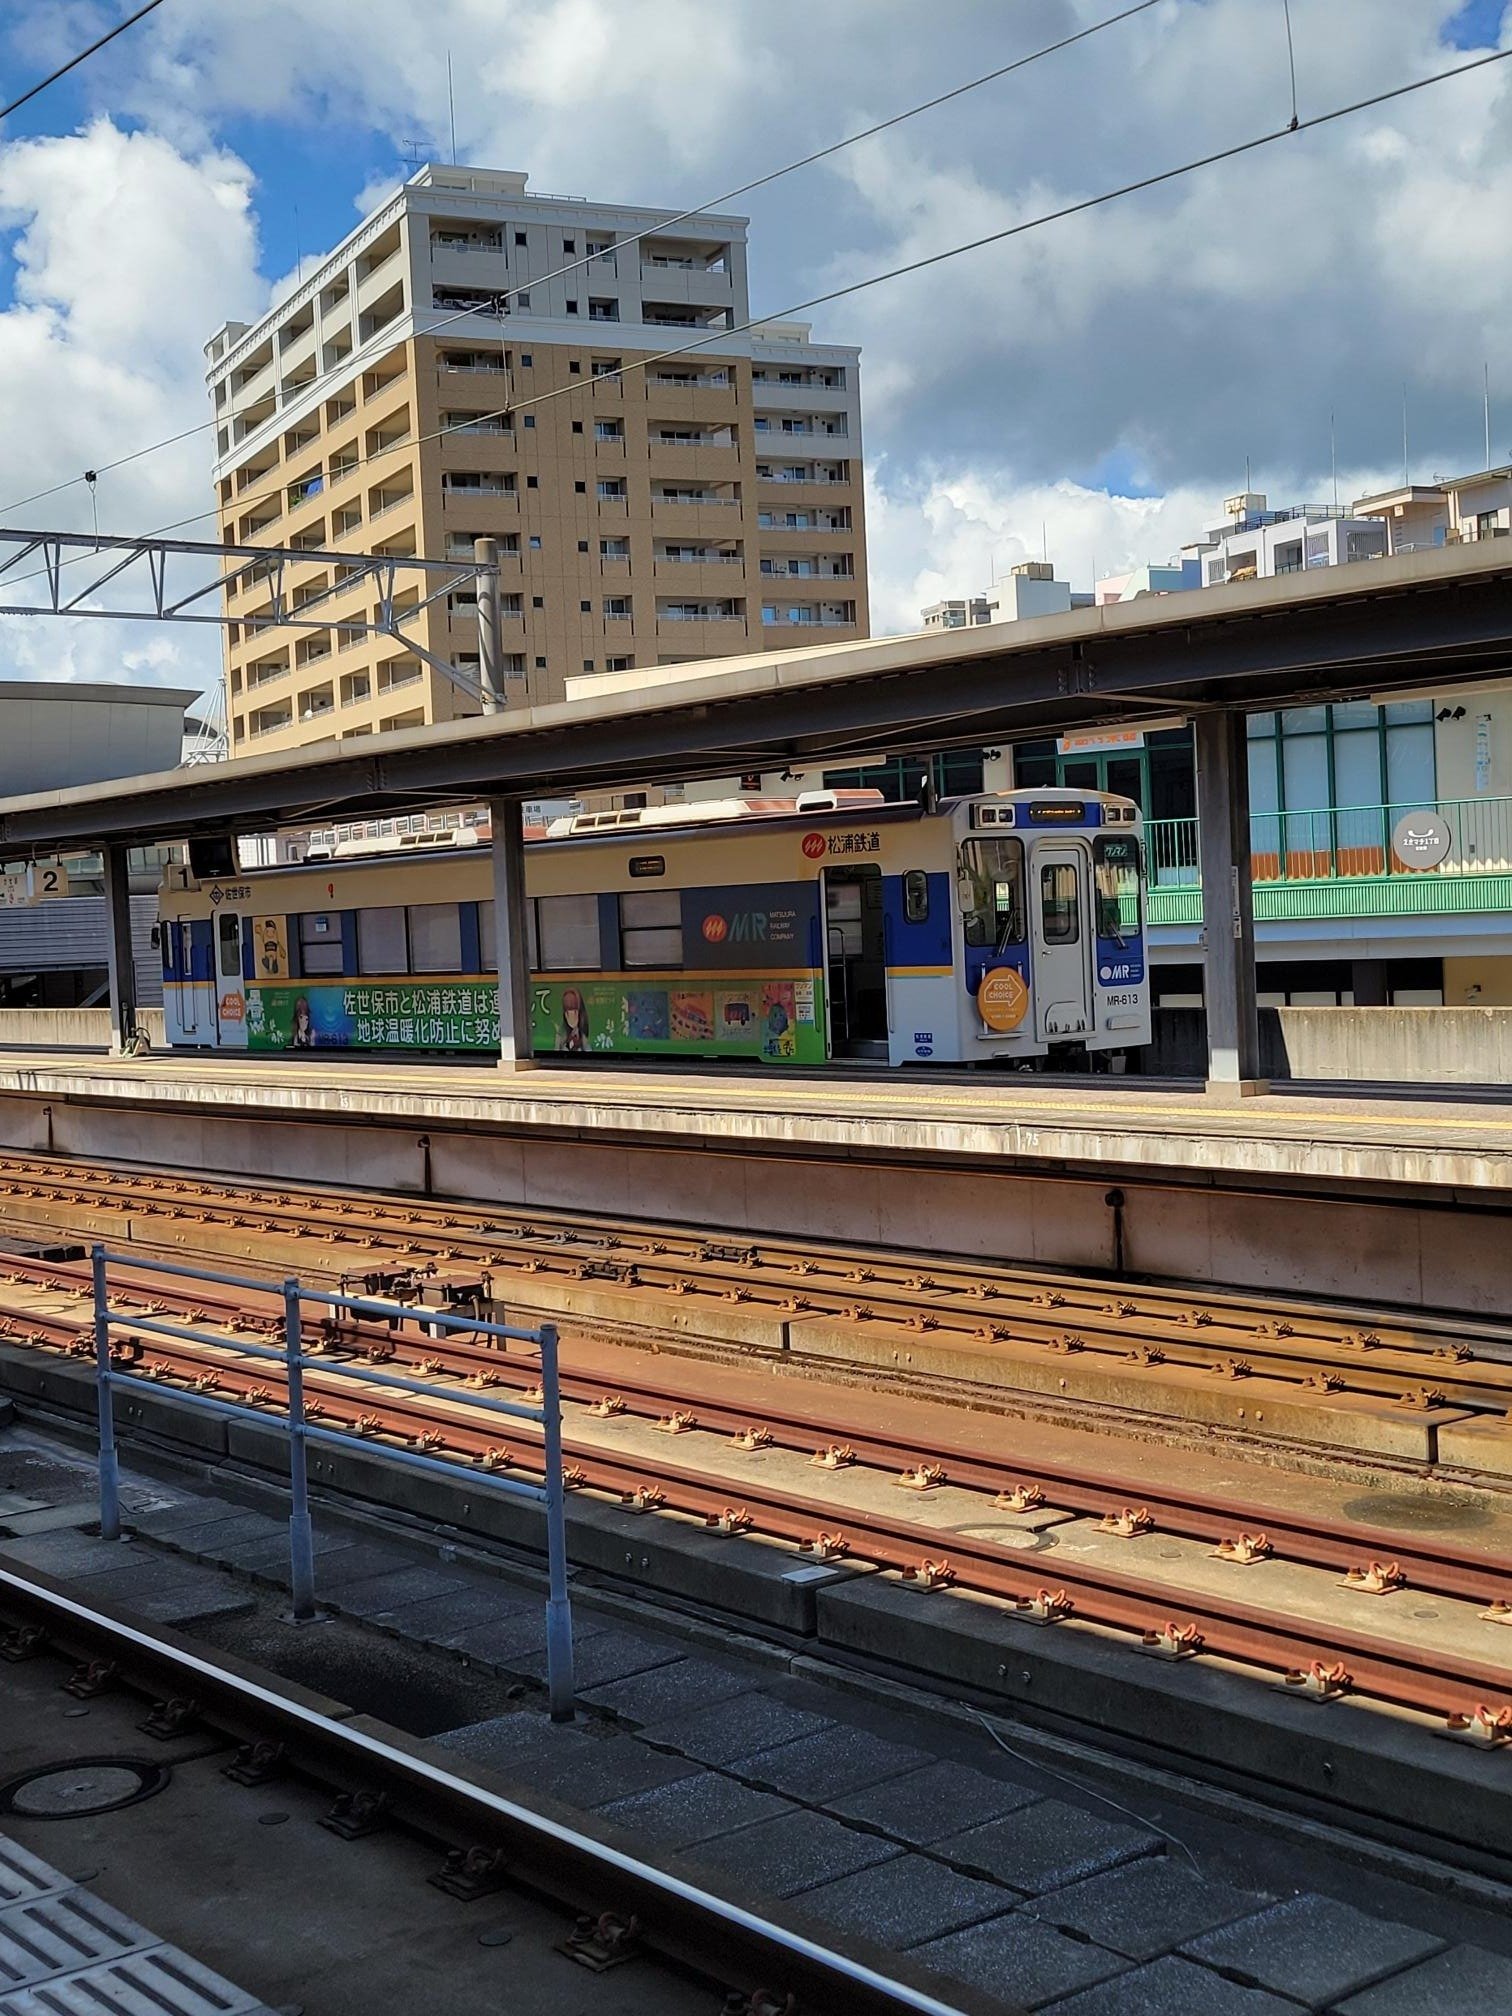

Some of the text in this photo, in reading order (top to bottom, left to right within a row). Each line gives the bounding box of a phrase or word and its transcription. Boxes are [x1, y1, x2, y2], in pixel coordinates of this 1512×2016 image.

[828, 832, 880, 854] 松浦鉄道
[43, 871, 58, 891] 2
[178, 868, 188, 888] 1
[225, 886, 251, 900] 佐世保市
[728, 912, 767, 942] MR
[1111, 964, 1130, 979] MR
[225, 997, 241, 1006] COOL
[343, 988, 550, 1015] 佐世保市と松浦鉄道は連て
[989, 991, 1014, 999] CHOICE
[1107, 993, 1139, 1006] MR-613
[1025, 1131, 1039, 1146] 75
